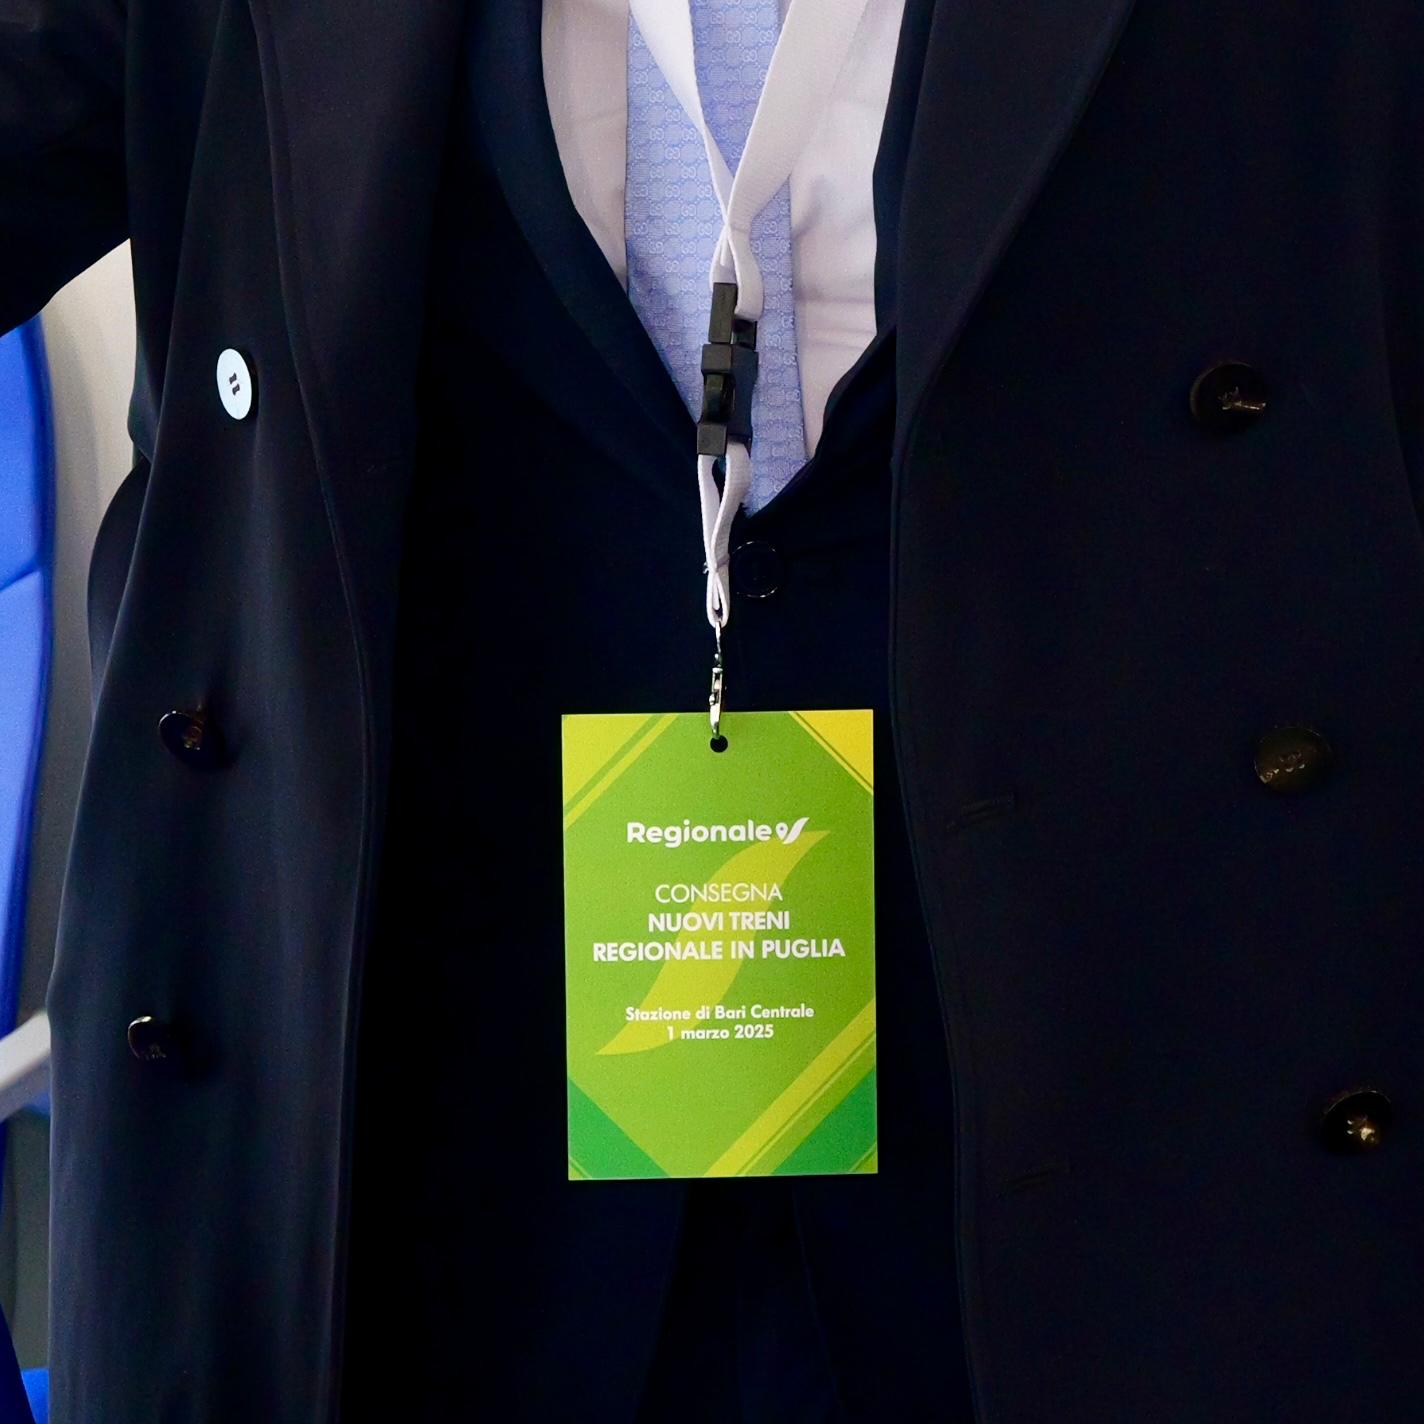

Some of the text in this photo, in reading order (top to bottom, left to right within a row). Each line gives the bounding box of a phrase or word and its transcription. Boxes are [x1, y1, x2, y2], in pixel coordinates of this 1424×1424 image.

[626, 818, 773, 849] Regionale
[654, 882, 784, 904] CONSEGNA
[648, 911, 791, 933] NUOVI TRENI
[592, 938, 846, 962] REGIONALE IN PUGLIA
[625, 1002, 815, 1022] Stazione di Bari Centrale
[667, 1023, 775, 1041] 1 marzo 2025
